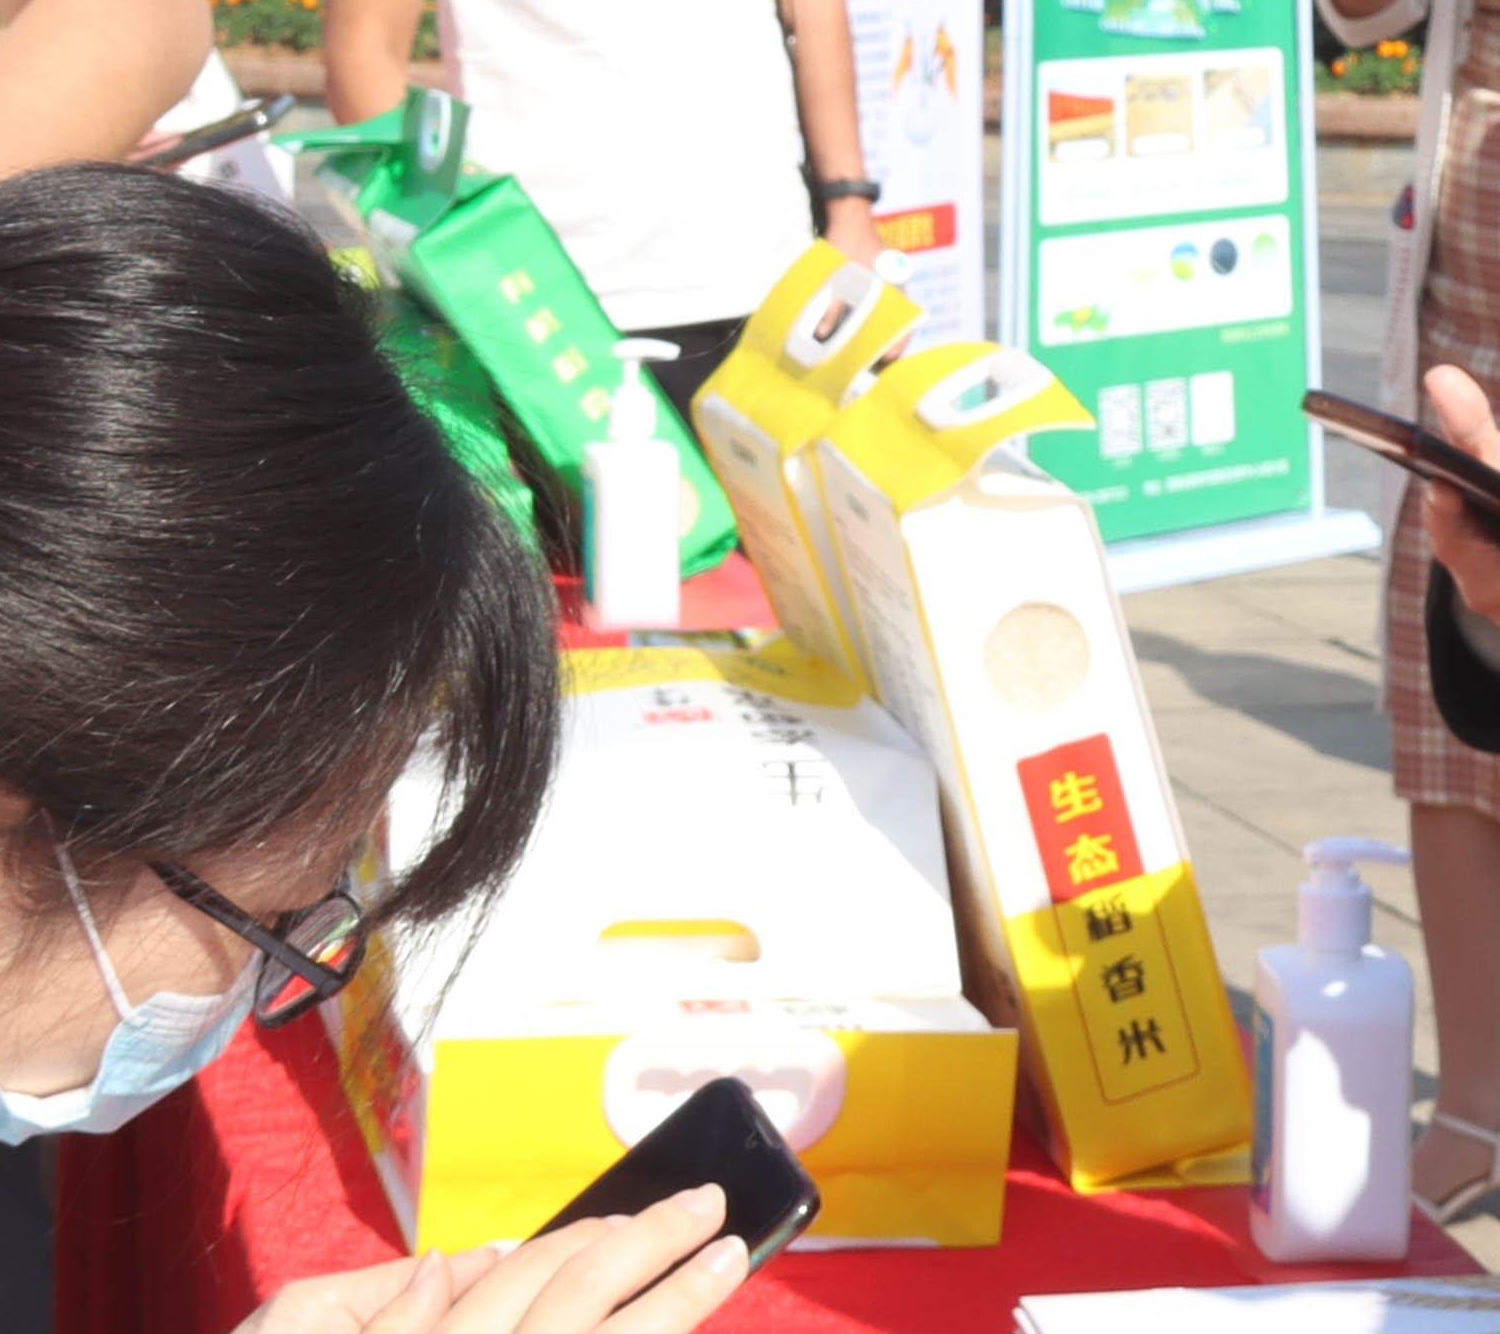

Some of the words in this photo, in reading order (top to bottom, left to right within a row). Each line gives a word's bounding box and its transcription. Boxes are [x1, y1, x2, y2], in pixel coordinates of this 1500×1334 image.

[1048, 771, 1120, 887] 生态
[1084, 893, 1168, 1067] 稻香米
